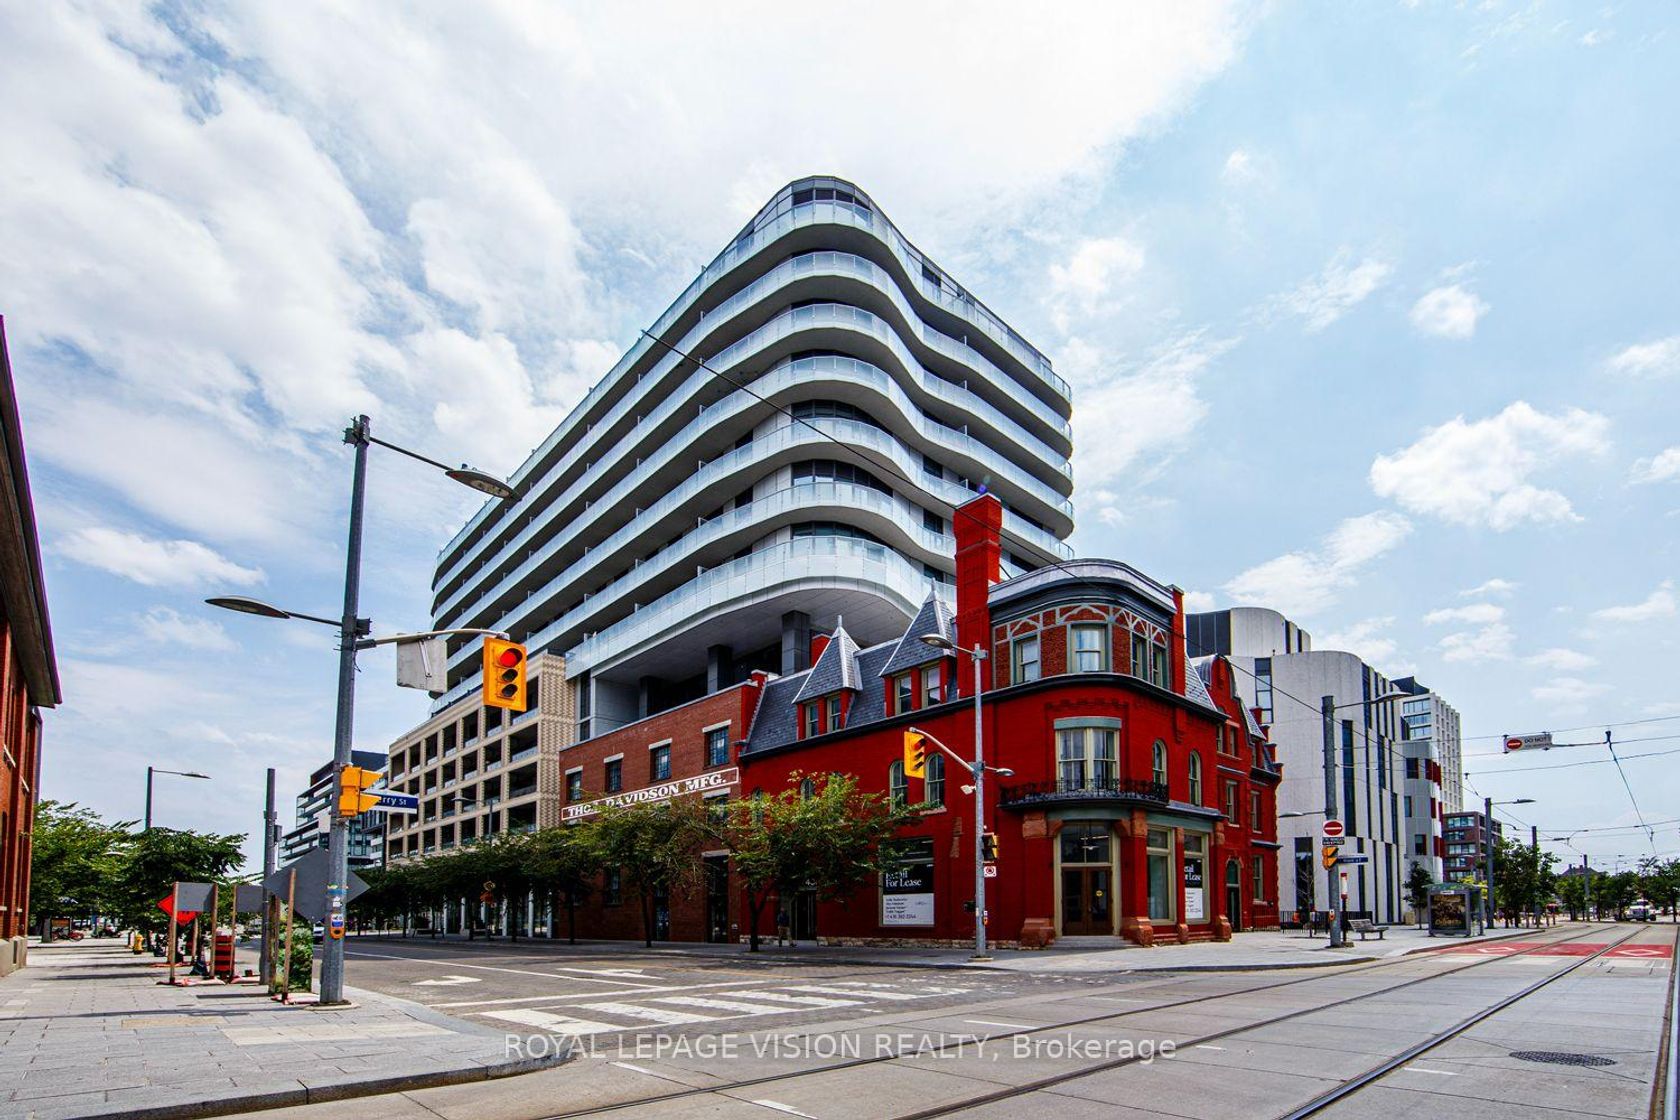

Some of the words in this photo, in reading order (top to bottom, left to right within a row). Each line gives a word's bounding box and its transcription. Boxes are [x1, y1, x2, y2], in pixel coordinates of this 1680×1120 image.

[606, 783, 680, 806] DAVIDSON
[685, 773, 727, 792] MFG.
[380, 797, 397, 806] rry
[886, 879, 898, 888] For
[900, 878, 922, 888] Lease
